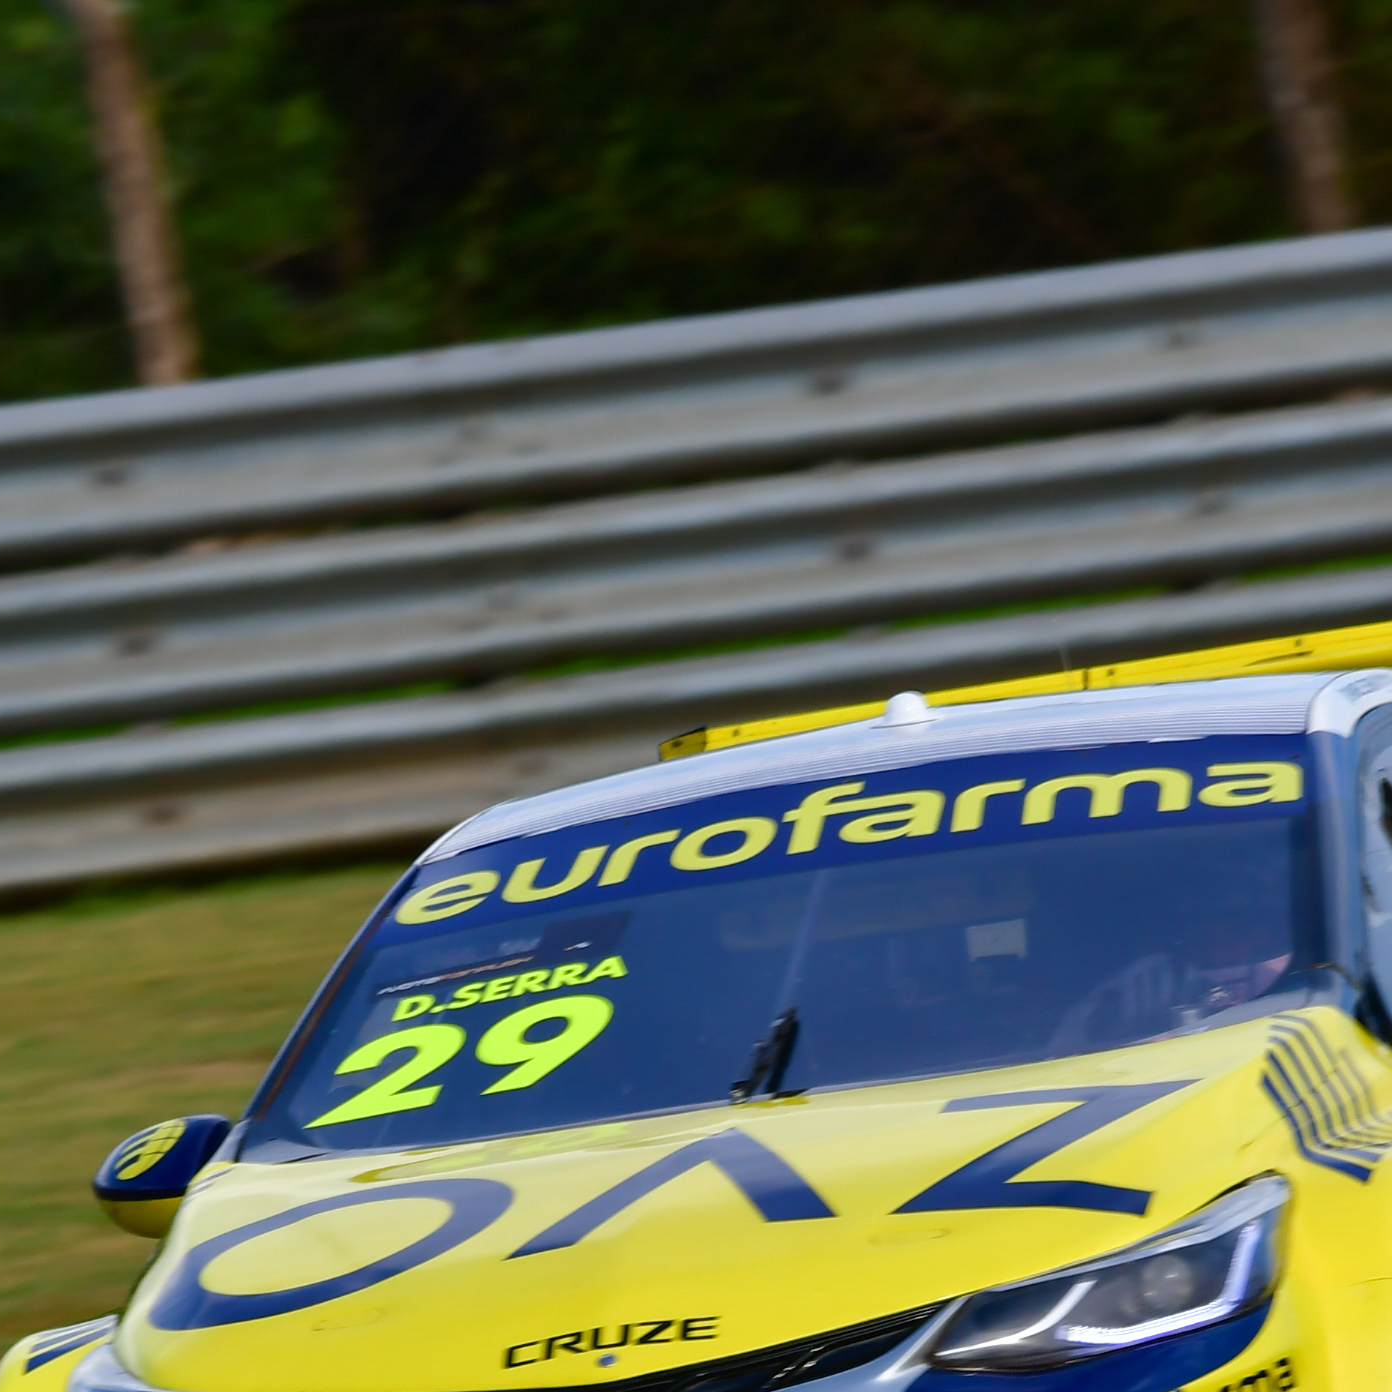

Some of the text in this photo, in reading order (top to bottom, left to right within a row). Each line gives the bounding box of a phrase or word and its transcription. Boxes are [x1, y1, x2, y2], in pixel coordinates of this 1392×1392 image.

[394, 760, 1304, 926] eurofarma
[391, 955, 629, 1022] D.SERRA
[301, 994, 615, 1130] 29
[502, 1315, 721, 1370] CRUZE
